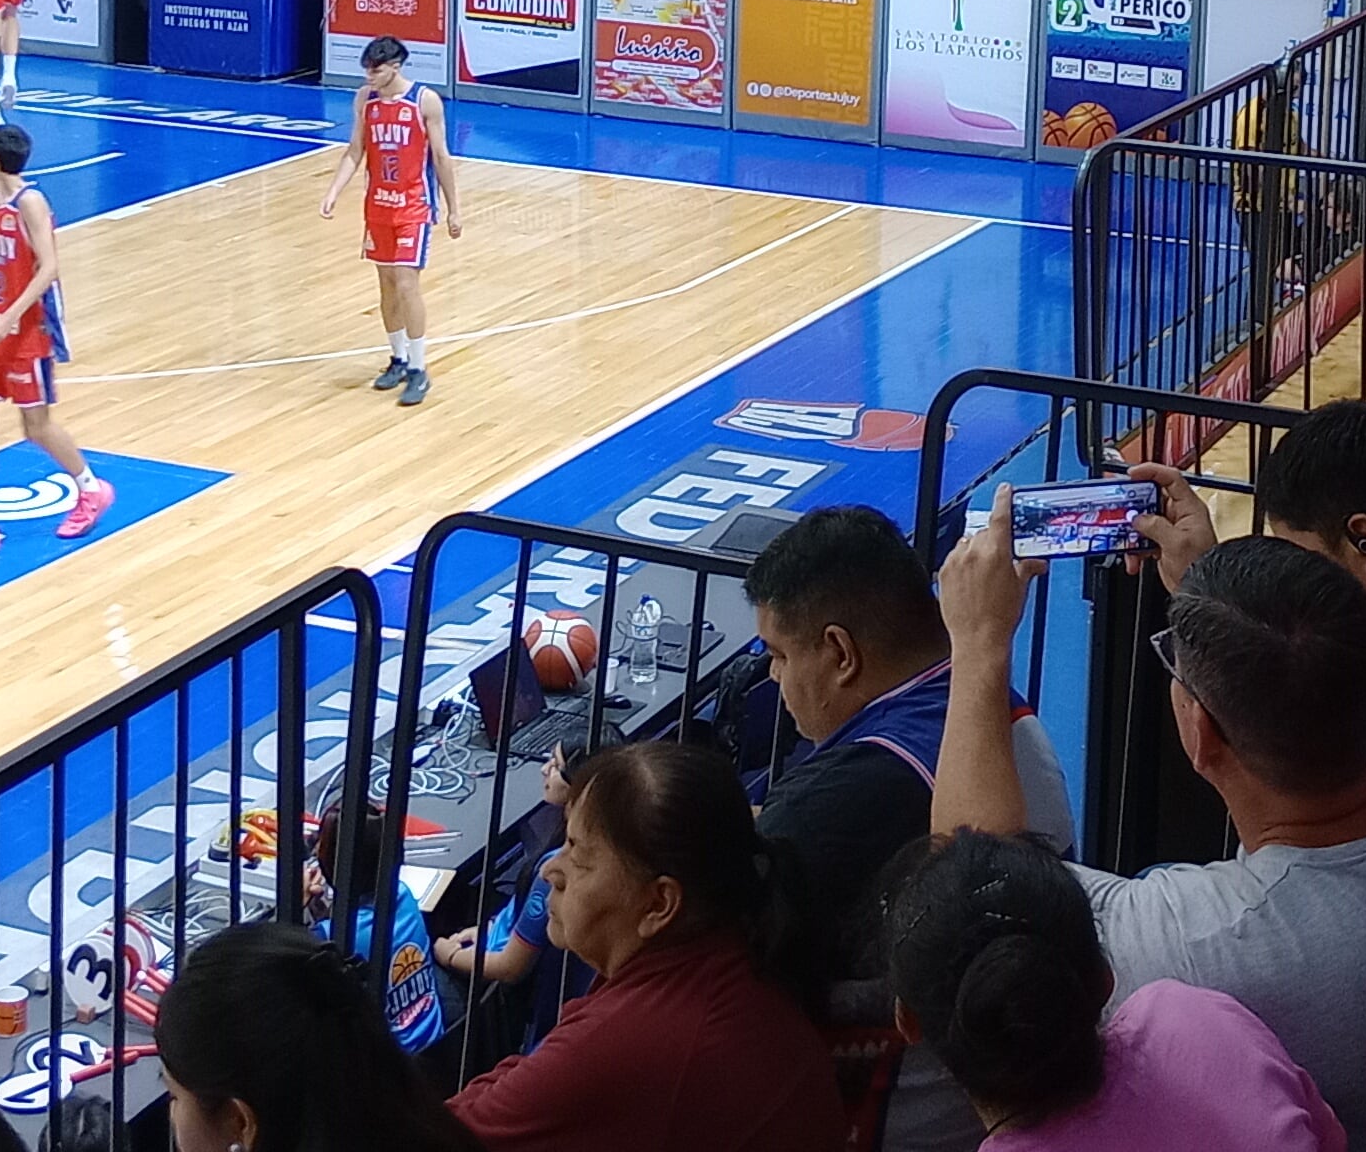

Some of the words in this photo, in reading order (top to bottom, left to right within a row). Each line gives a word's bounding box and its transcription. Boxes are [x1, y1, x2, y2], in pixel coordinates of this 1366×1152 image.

[164, 4, 203, 17] INSTITUTO
[205, 7, 249, 21] PROVINCIAL
[164, 16, 175, 26] DE
[178, 18, 210, 29] JUEGOS
[214, 20, 224, 30] DE
[227, 22, 249, 33] AZAR
[615, 25, 702, 62] Luisiño
[895, 29, 990, 46] SANATORIO
[896, 38, 925, 51] LOS
[935, 41, 1022, 61] LAPACHOS
[773, 85, 860, 108] @DeportesJujuy
[370, 124, 411, 145] JUJUY
[67, 944, 113, 1001] 3
